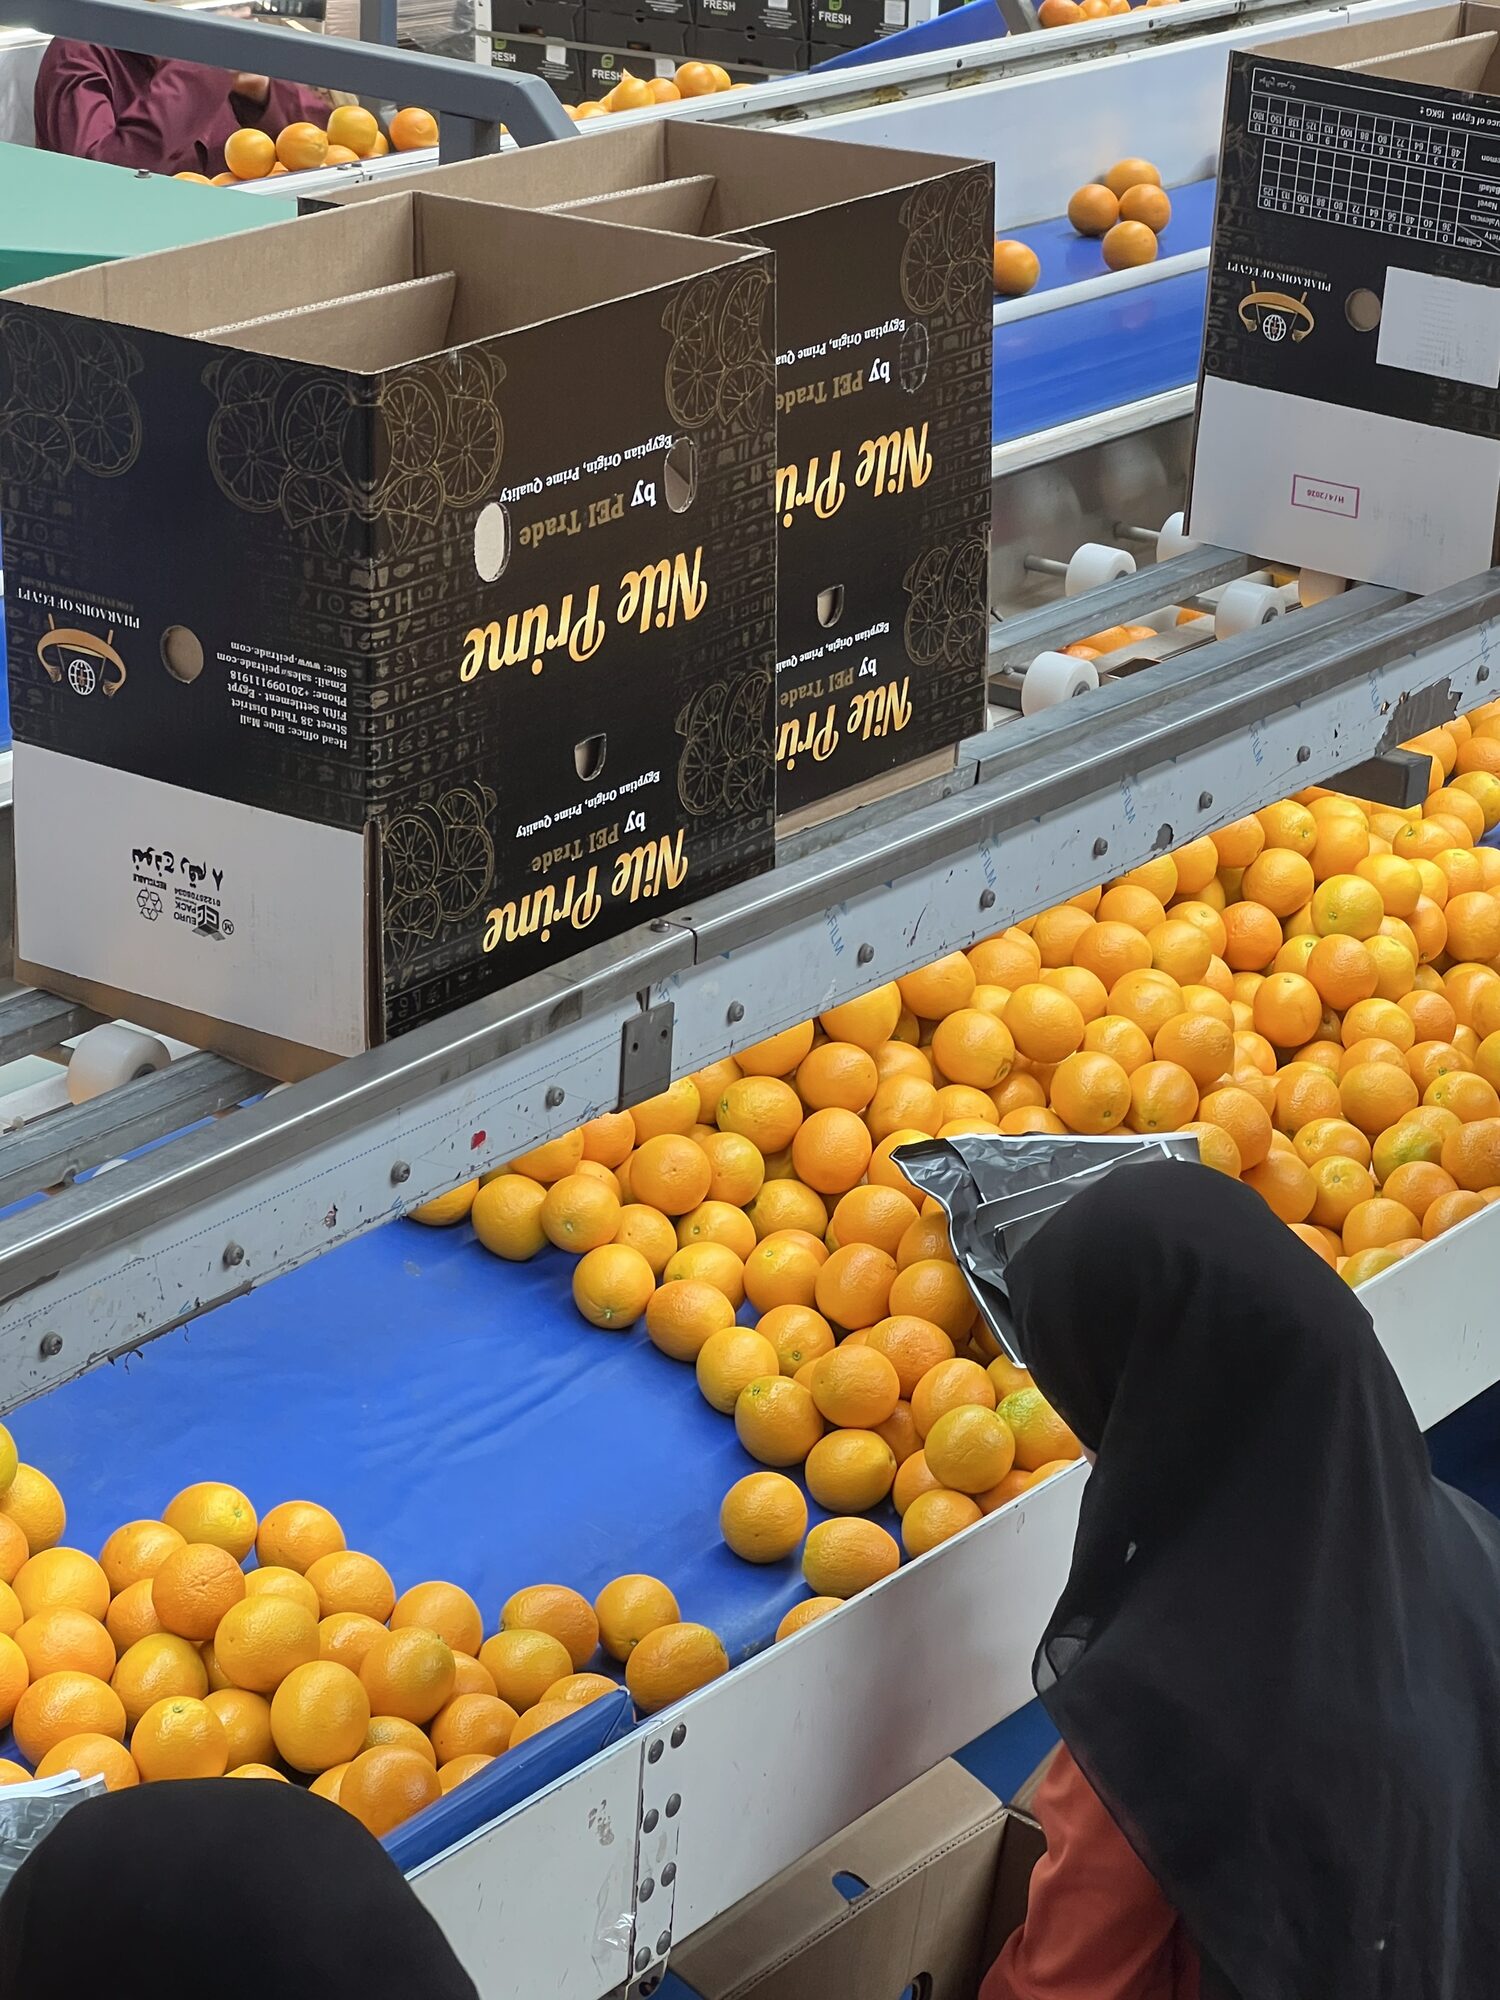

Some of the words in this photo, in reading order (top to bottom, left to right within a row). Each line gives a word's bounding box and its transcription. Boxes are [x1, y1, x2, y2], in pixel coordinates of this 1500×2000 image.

[703, 0, 736, 12] FRESH
[818, 10, 852, 24] FRESH
[491, 51, 516, 63] RESH
[592, 68, 623, 82] FRESH
[1426, 108, 1444, 119] 15KG
[1452, 112, 1475, 124] Egypt
[1254, 122, 1260, 131] 13
[1272, 126, 1278, 134] 12
[1476, 118, 1485, 126] of
[1289, 130, 1295, 138] 11
[1306, 133, 1313, 141] 10
[1343, 140, 1348, 148] 8
[1379, 147, 1383, 155] 6
[1416, 154, 1420, 162] 4
[1433, 157, 1438, 165] 3
[1452, 160, 1457, 168] 2
[1481, 155, 1500, 164] emon
[1264, 198, 1271, 207] 10
[1300, 206, 1304, 214] 8
[1478, 200, 1498, 211] Navel
[1335, 213, 1340, 221] 6
[1371, 220, 1375, 228] 4
[1470, 214, 1500, 227] Valencia
[1406, 227, 1411, 235] 2
[1442, 234, 1448, 242] 0
[1457, 236, 1482, 248] Caliber
[1226, 262, 1259, 277] EGYPT
[1260, 269, 1274, 280] OF
[1276, 272, 1332, 292] PHARAOHS
[864, 317, 906, 338] Egyptian
[828, 332, 862, 351] Origin,
[798, 342, 826, 362] Prime
[868, 357, 891, 383] by
[832, 369, 864, 399] PEI
[776, 380, 827, 414] Trade
[624, 434, 672, 460] Egyptian
[582, 453, 620, 474] Origin,
[854, 421, 933, 498] Nile
[545, 467, 580, 488] Prime
[500, 476, 543, 503] Quality
[630, 480, 656, 507] by
[776, 450, 845, 528] Pri
[586, 493, 624, 528] PEI
[519, 508, 582, 549] Trade
[16, 588, 55, 607] EGYPT
[616, 546, 708, 634] Nile
[57, 598, 73, 612] OF
[75, 602, 140, 629] PHARAOHS
[460, 584, 605, 682] Prime
[854, 622, 890, 642] Egyptian
[825, 636, 853, 652] Origin,
[230, 642, 321, 670] www.peitrade.com
[799, 646, 824, 662] Prime
[324, 665, 347, 678] Site:
[776, 654, 798, 673] Quali
[858, 656, 877, 677] by
[230, 670, 309, 696] +201099111918
[315, 677, 347, 692] Email:
[828, 667, 854, 692] PEI
[227, 683, 255, 699] Egypt
[312, 691, 347, 707] Phone:
[780, 679, 824, 708] Trade
[231, 698, 268, 715] District
[265, 692, 319, 714] Settlement
[846, 675, 913, 741] Nile
[240, 714, 261, 728] Mall
[270, 708, 298, 723] Third
[300, 716, 313, 726] 38
[322, 707, 347, 721] Fifth
[263, 721, 285, 734] Blue
[288, 727, 319, 740] office:
[316, 720, 347, 735] Street
[322, 735, 347, 749] Head
[776, 704, 839, 771] Pri
[619, 770, 660, 796] Egyptian
[584, 789, 617, 809] Origin,
[554, 804, 582, 822] Prime
[516, 815, 552, 838] Quality
[624, 810, 646, 834] by
[588, 822, 619, 854] PEI
[530, 839, 583, 874] Trade
[132, 847, 174, 877] نموذج
[180, 857, 206, 888] رقم
[611, 828, 689, 904] Nile
[175, 901, 196, 914] PACK
[482, 865, 602, 953] Prime
[174, 912, 196, 926] EURO
